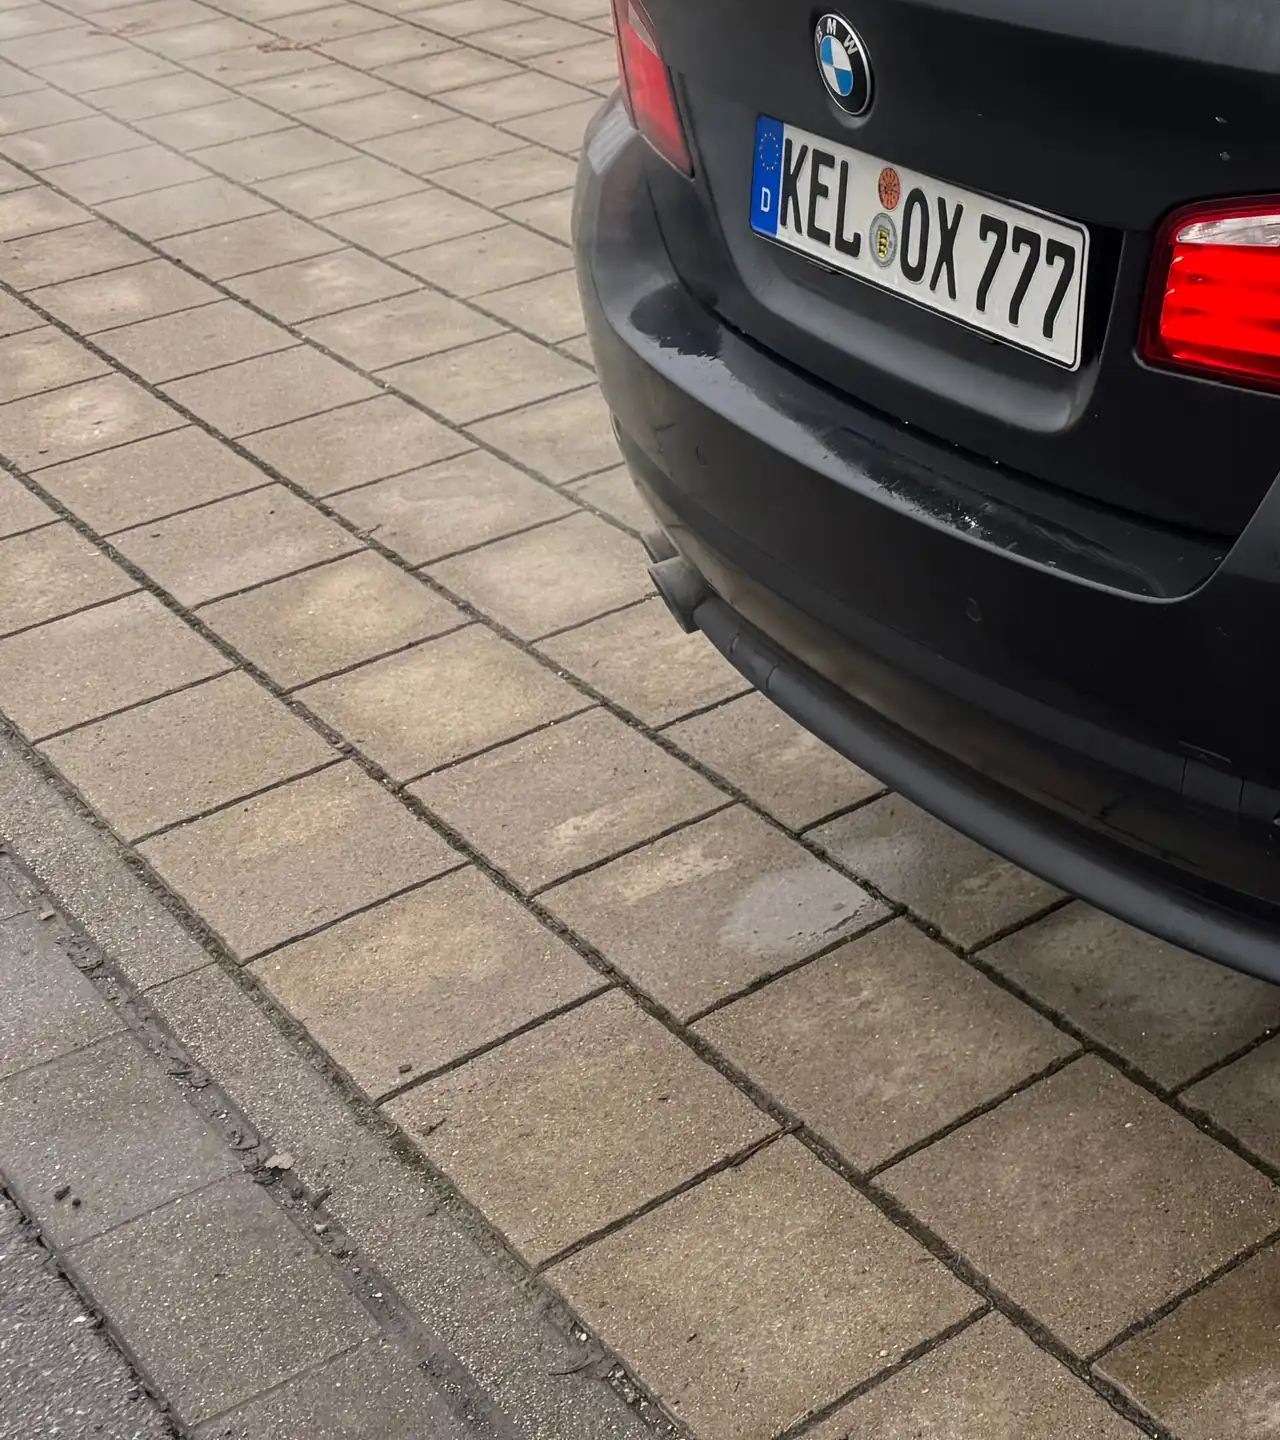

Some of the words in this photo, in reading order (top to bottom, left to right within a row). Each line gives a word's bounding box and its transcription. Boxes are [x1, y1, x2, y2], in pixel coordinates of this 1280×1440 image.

[815, 17, 858, 56] BMW
[761, 186, 771, 213] D
[780, 138, 862, 258] KEL
[901, 187, 964, 300] OX
[976, 214, 1076, 340] 777
